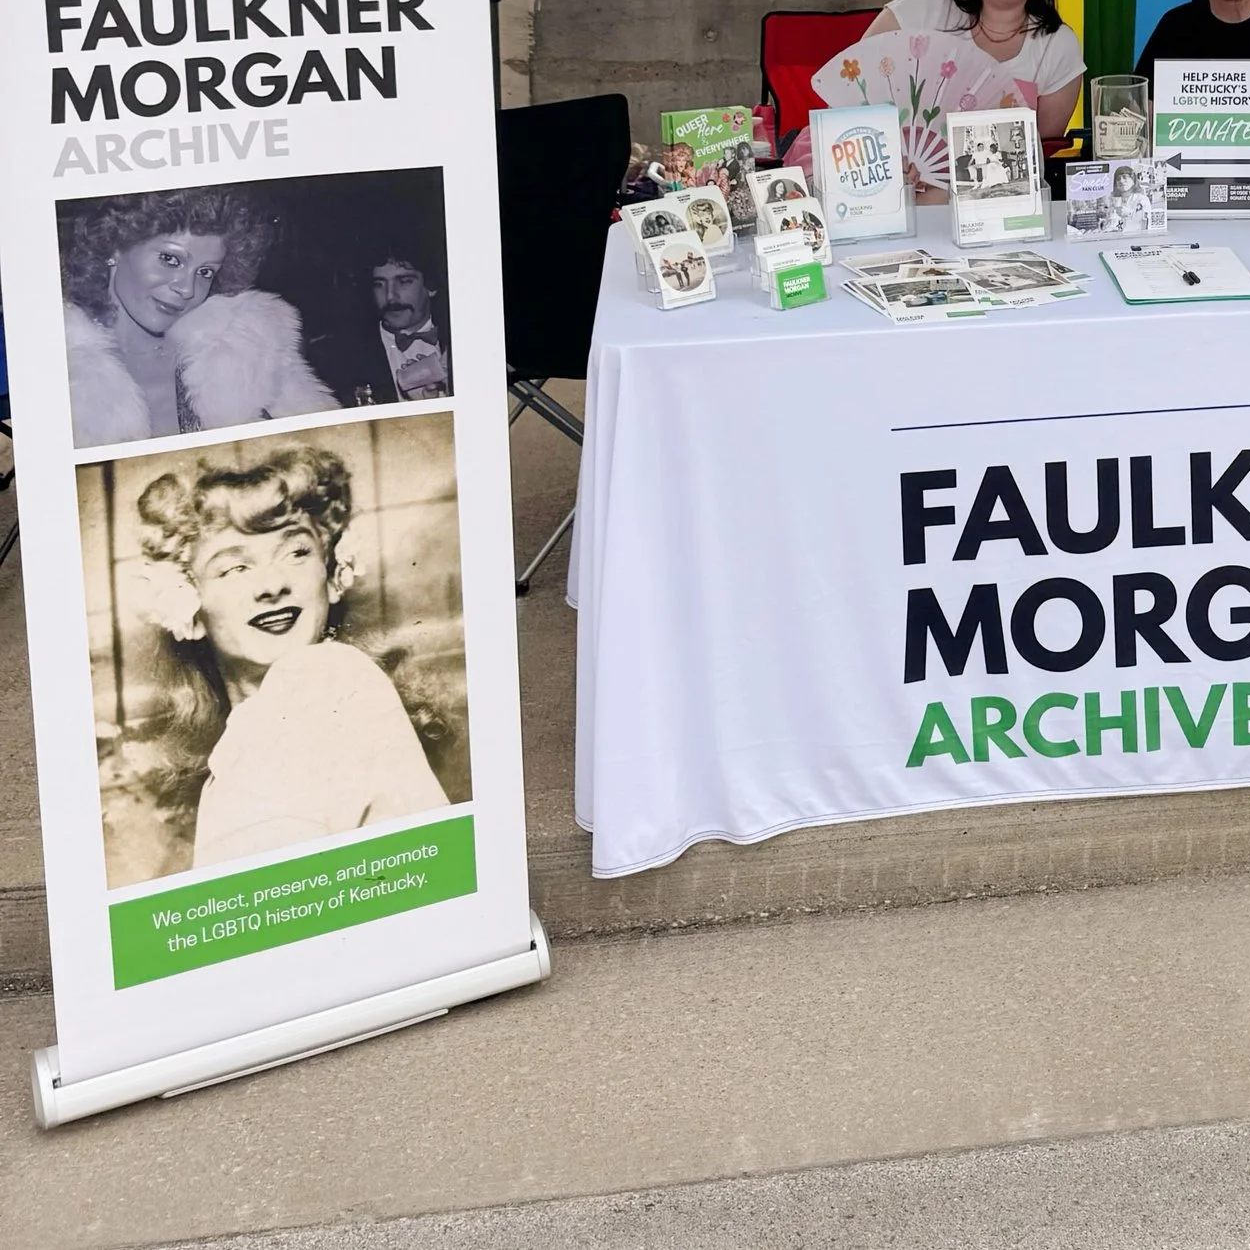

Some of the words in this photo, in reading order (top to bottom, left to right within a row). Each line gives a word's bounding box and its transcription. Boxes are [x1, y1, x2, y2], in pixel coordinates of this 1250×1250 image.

[51, 46, 398, 124] MORGAN
[1181, 84, 1247, 94] KENTUCKY'S
[1183, 72, 1208, 82] HELP
[1211, 72, 1246, 82] SHARE
[1173, 96, 1208, 107] LGBTQ
[675, 114, 709, 137] QUEER
[697, 123, 723, 138] Here
[53, 118, 290, 177] ARCHIVE
[695, 134, 750, 157] EVERYWHERE
[831, 131, 891, 173] PRIDE
[840, 171, 850, 183] of
[851, 161, 892, 188] PLACE
[152, 911, 182, 930] We
[186, 893, 249, 921] collect,
[254, 874, 332, 907] preserve,
[336, 859, 366, 881] and
[371, 843, 439, 876] promote
[167, 933, 198, 952] the
[202, 916, 261, 943] LGBTQ
[266, 897, 324, 926] history
[329, 891, 346, 910] of
[350, 871, 428, 903] Kentucky.
